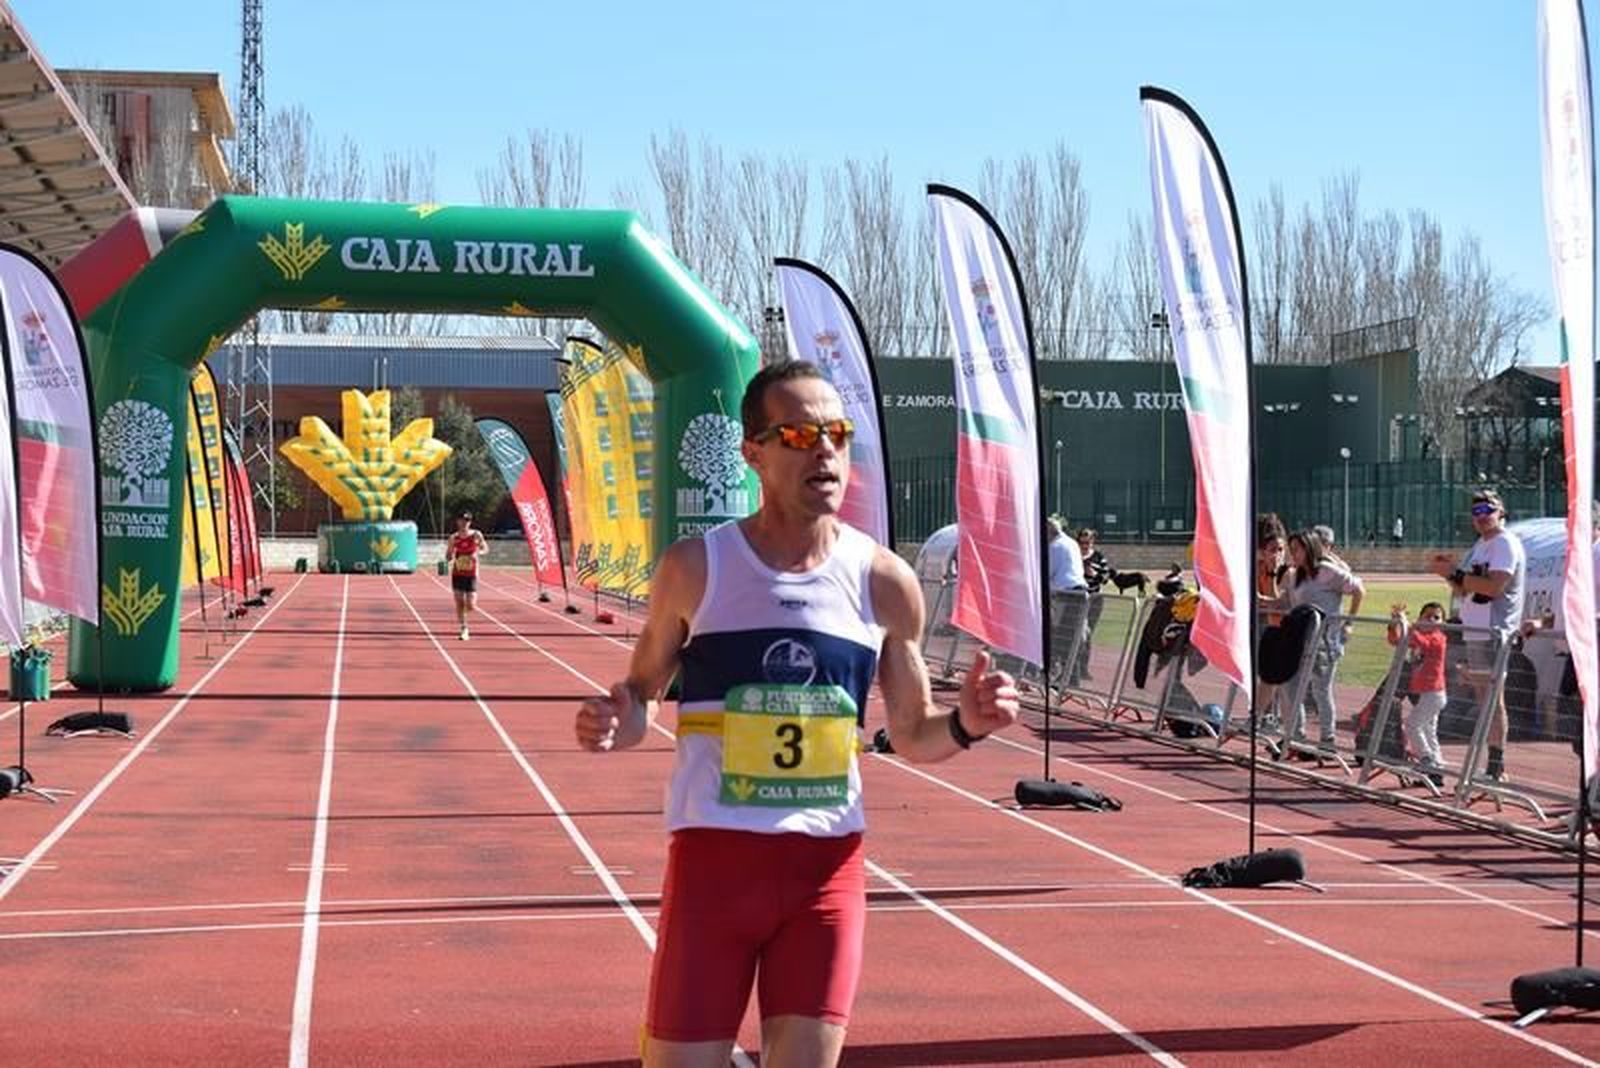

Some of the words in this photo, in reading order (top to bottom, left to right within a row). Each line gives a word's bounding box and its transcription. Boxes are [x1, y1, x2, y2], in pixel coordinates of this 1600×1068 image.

[341, 237, 441, 273] CAJA
[453, 240, 595, 278] RURAL
[883, 394, 891, 407] E
[896, 394, 956, 407] ZAMORA
[1062, 390, 1124, 410] CAJA
[1133, 391, 1185, 410] RUR
[102, 511, 169, 525] UNDACION
[102, 524, 123, 537] AJA
[127, 525, 169, 538] RURAL
[766, 702, 795, 713] CAJA
[773, 723, 803, 769] 3
[758, 785, 793, 799] CAJA
[797, 784, 842, 799] RURAL
